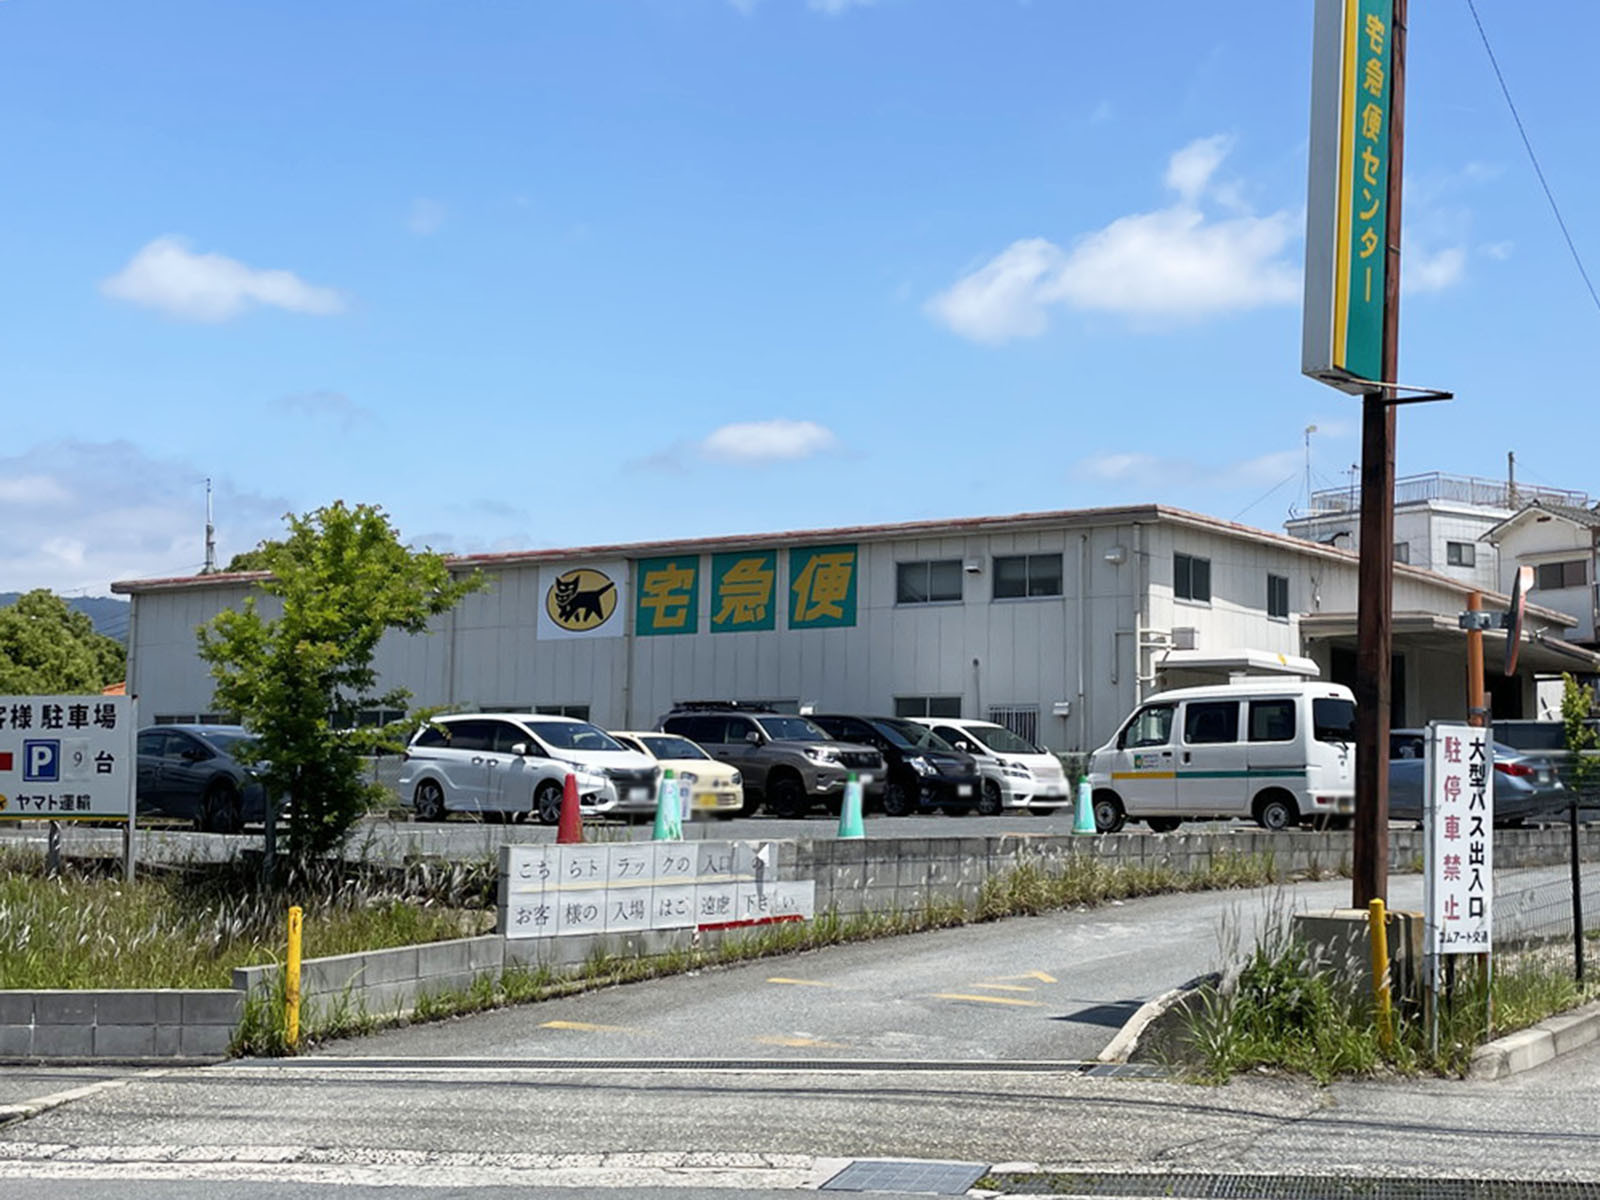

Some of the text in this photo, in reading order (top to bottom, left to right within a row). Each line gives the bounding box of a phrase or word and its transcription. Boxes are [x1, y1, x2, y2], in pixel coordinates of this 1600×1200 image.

[1359, 14, 1386, 302] 宅急便センター
[640, 552, 855, 629] 宅急便
[16, 794, 91, 811] ヤマト運輸
[1443, 736, 1462, 920] 駐停車禁止
[1468, 737, 1486, 919] 大型バス出入口
